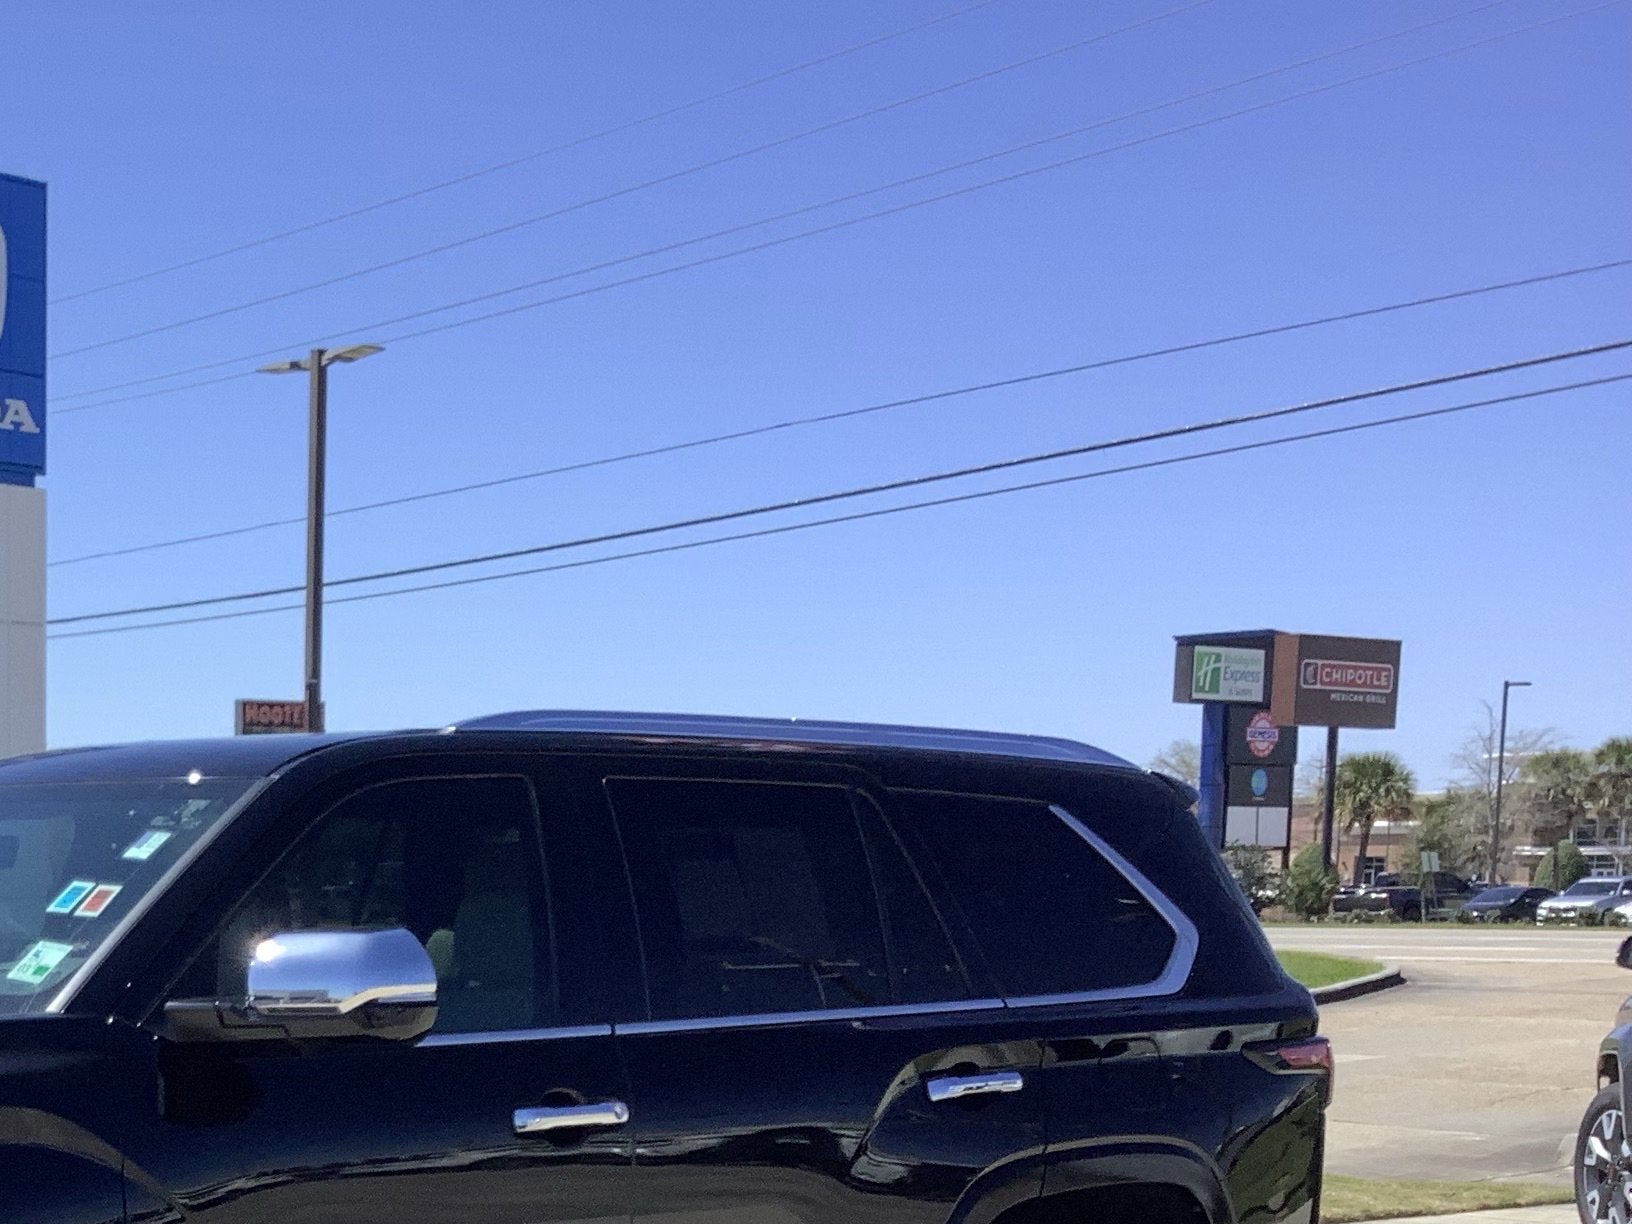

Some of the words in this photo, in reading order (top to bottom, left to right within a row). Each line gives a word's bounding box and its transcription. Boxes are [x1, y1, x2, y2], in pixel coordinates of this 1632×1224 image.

[1223, 666, 1261, 684] Express
[1322, 667, 1389, 686] CHIPOTLE
[1330, 693, 1363, 703] MEXICAN
[1365, 694, 1386, 704] GRILL
[245, 703, 305, 726] HOOTE
